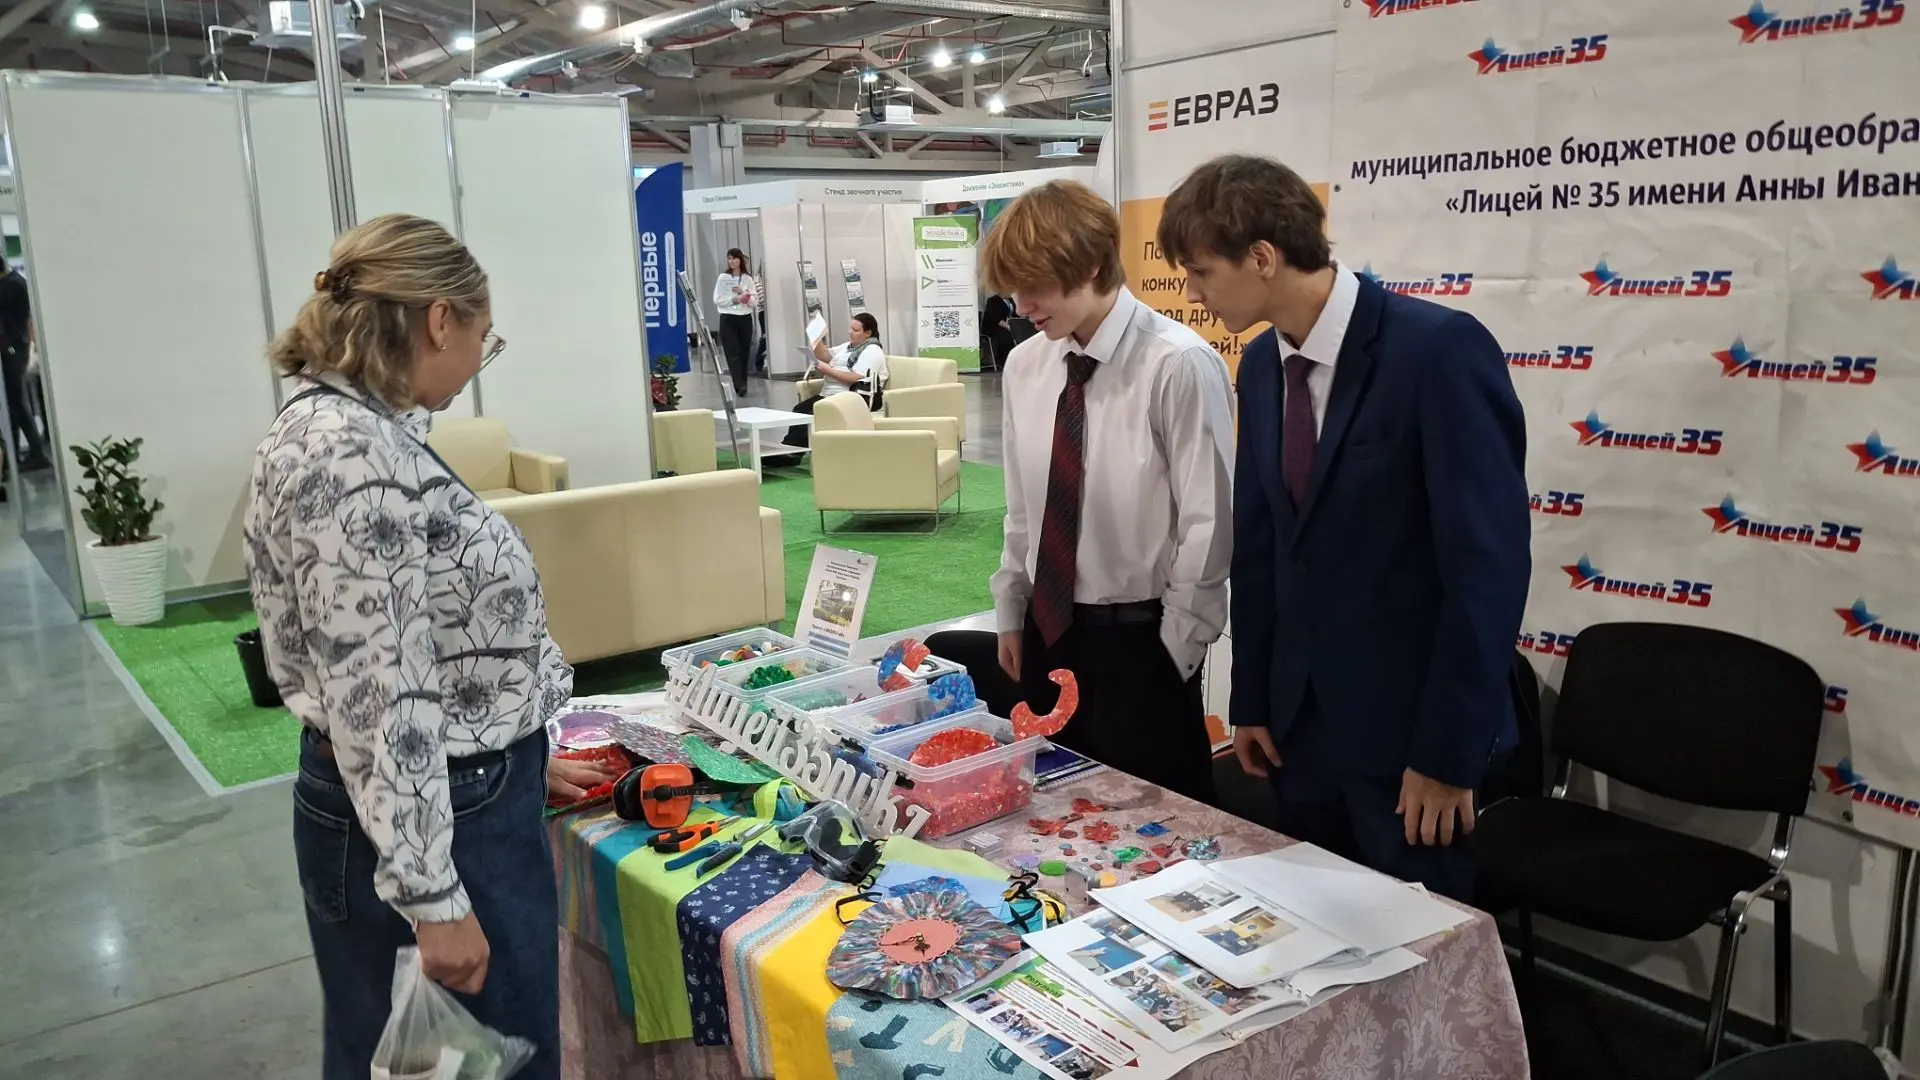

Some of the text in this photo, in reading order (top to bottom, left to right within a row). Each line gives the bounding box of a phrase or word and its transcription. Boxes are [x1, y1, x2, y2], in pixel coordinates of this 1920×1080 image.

[1746, 0, 1904, 43] Лицей 35
[1481, 34, 1608, 75] Лицей 35
[1173, 82, 1280, 127] ЕВРАЗ
[1350, 112, 1920, 184] муниципальное бюджетное общеобра
[1445, 168, 1920, 217] «Лицей № 35 имени Анны Иван
[641, 231, 666, 327] Первые
[1434, 273, 1474, 296] 35
[1591, 270, 1733, 297] Лицей 35
[1551, 345, 1594, 371] 35
[1727, 356, 1878, 385] Лицей 35
[1583, 428, 1724, 456] Лицей 35
[1542, 490, 1585, 517] 35
[1717, 518, 1863, 554] Лицей 35
[1575, 575, 1713, 608] Лицей 35
[1535, 631, 1576, 657] 35
